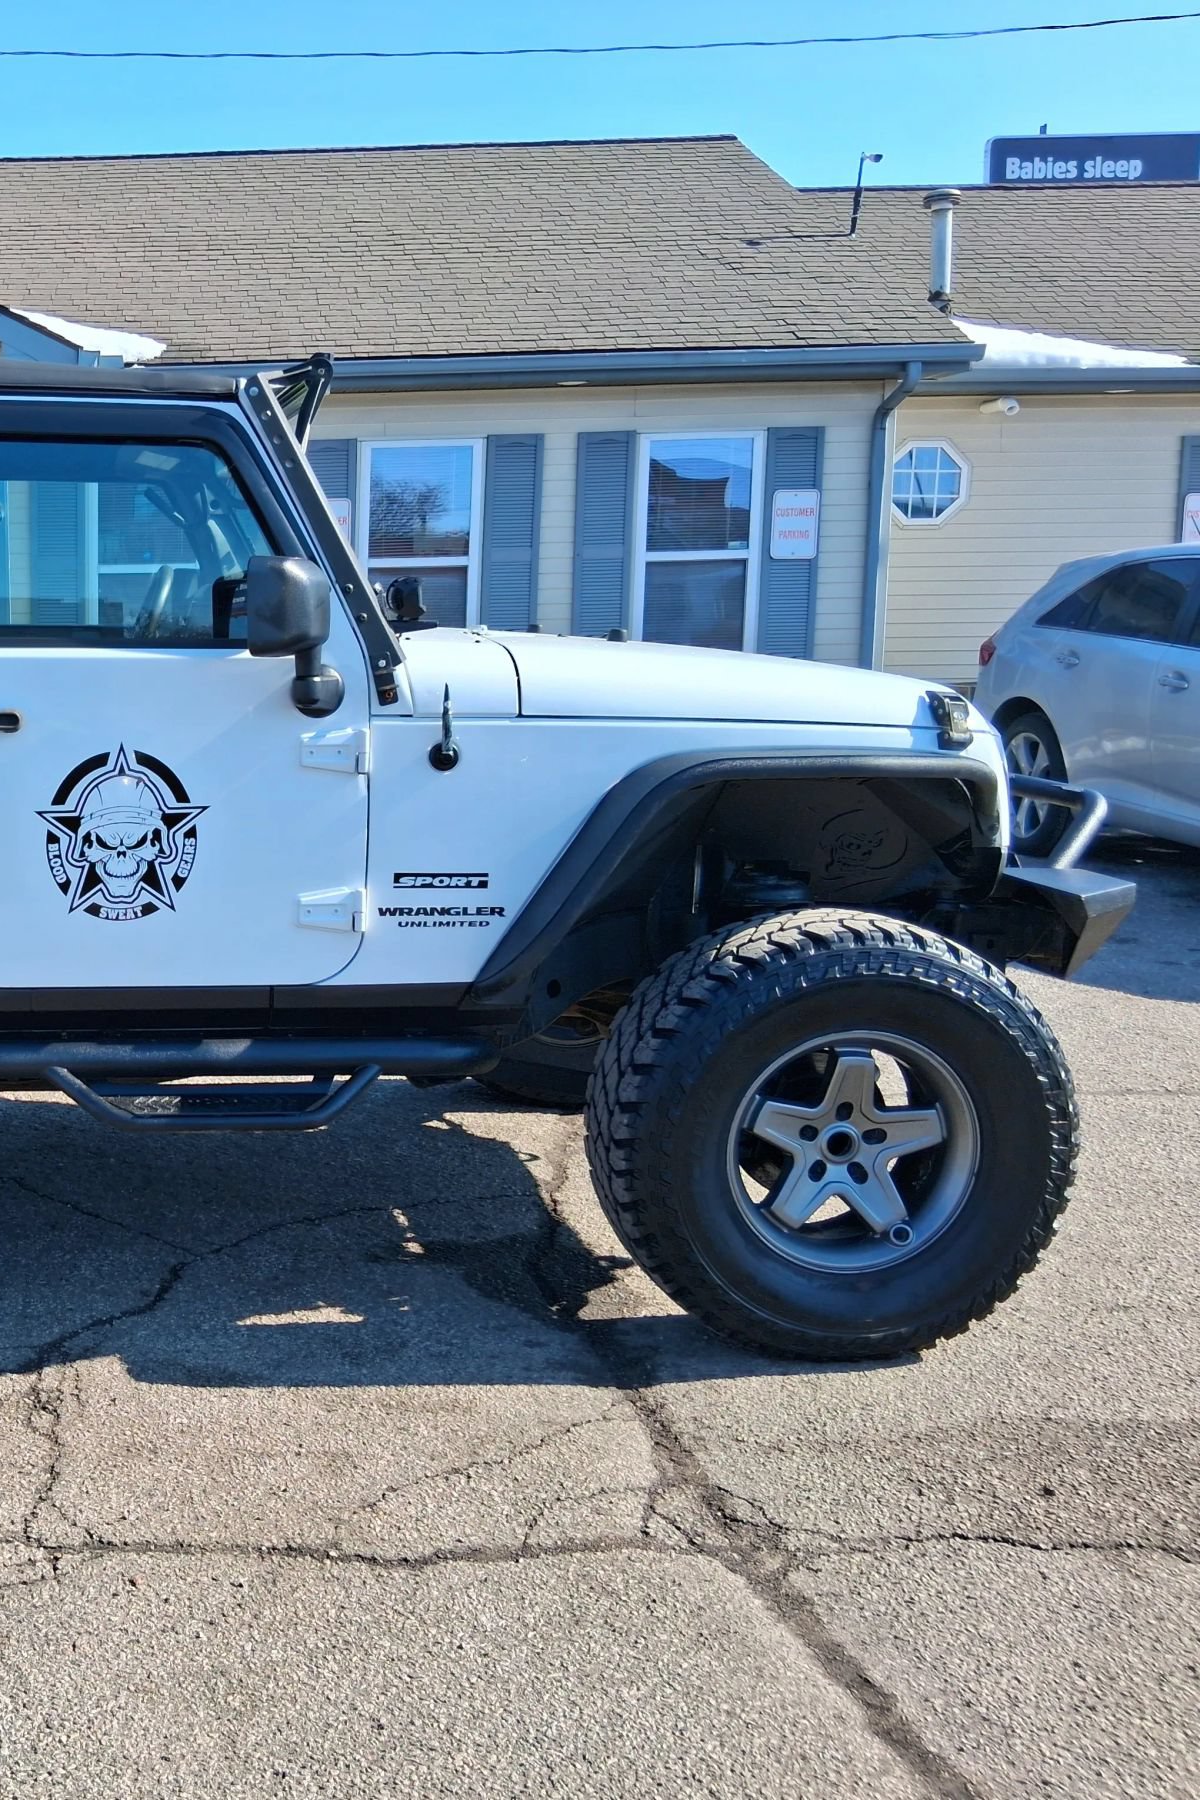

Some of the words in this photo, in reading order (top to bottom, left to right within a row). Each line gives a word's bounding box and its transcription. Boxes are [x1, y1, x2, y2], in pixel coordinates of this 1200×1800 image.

[1005, 157, 1078, 179] Babies
[1083, 156, 1143, 180] sleep
[775, 507, 815, 517] CUSTOMER
[778, 530, 810, 540] PARKING
[47, 843, 67, 884] BLOOD
[177, 837, 196, 878] GEARS
[394, 875, 488, 887] SPORT
[98, 906, 143, 920] SWEAT
[377, 906, 506, 917] WRANGLER
[397, 920, 490, 928] UNLIMITED
